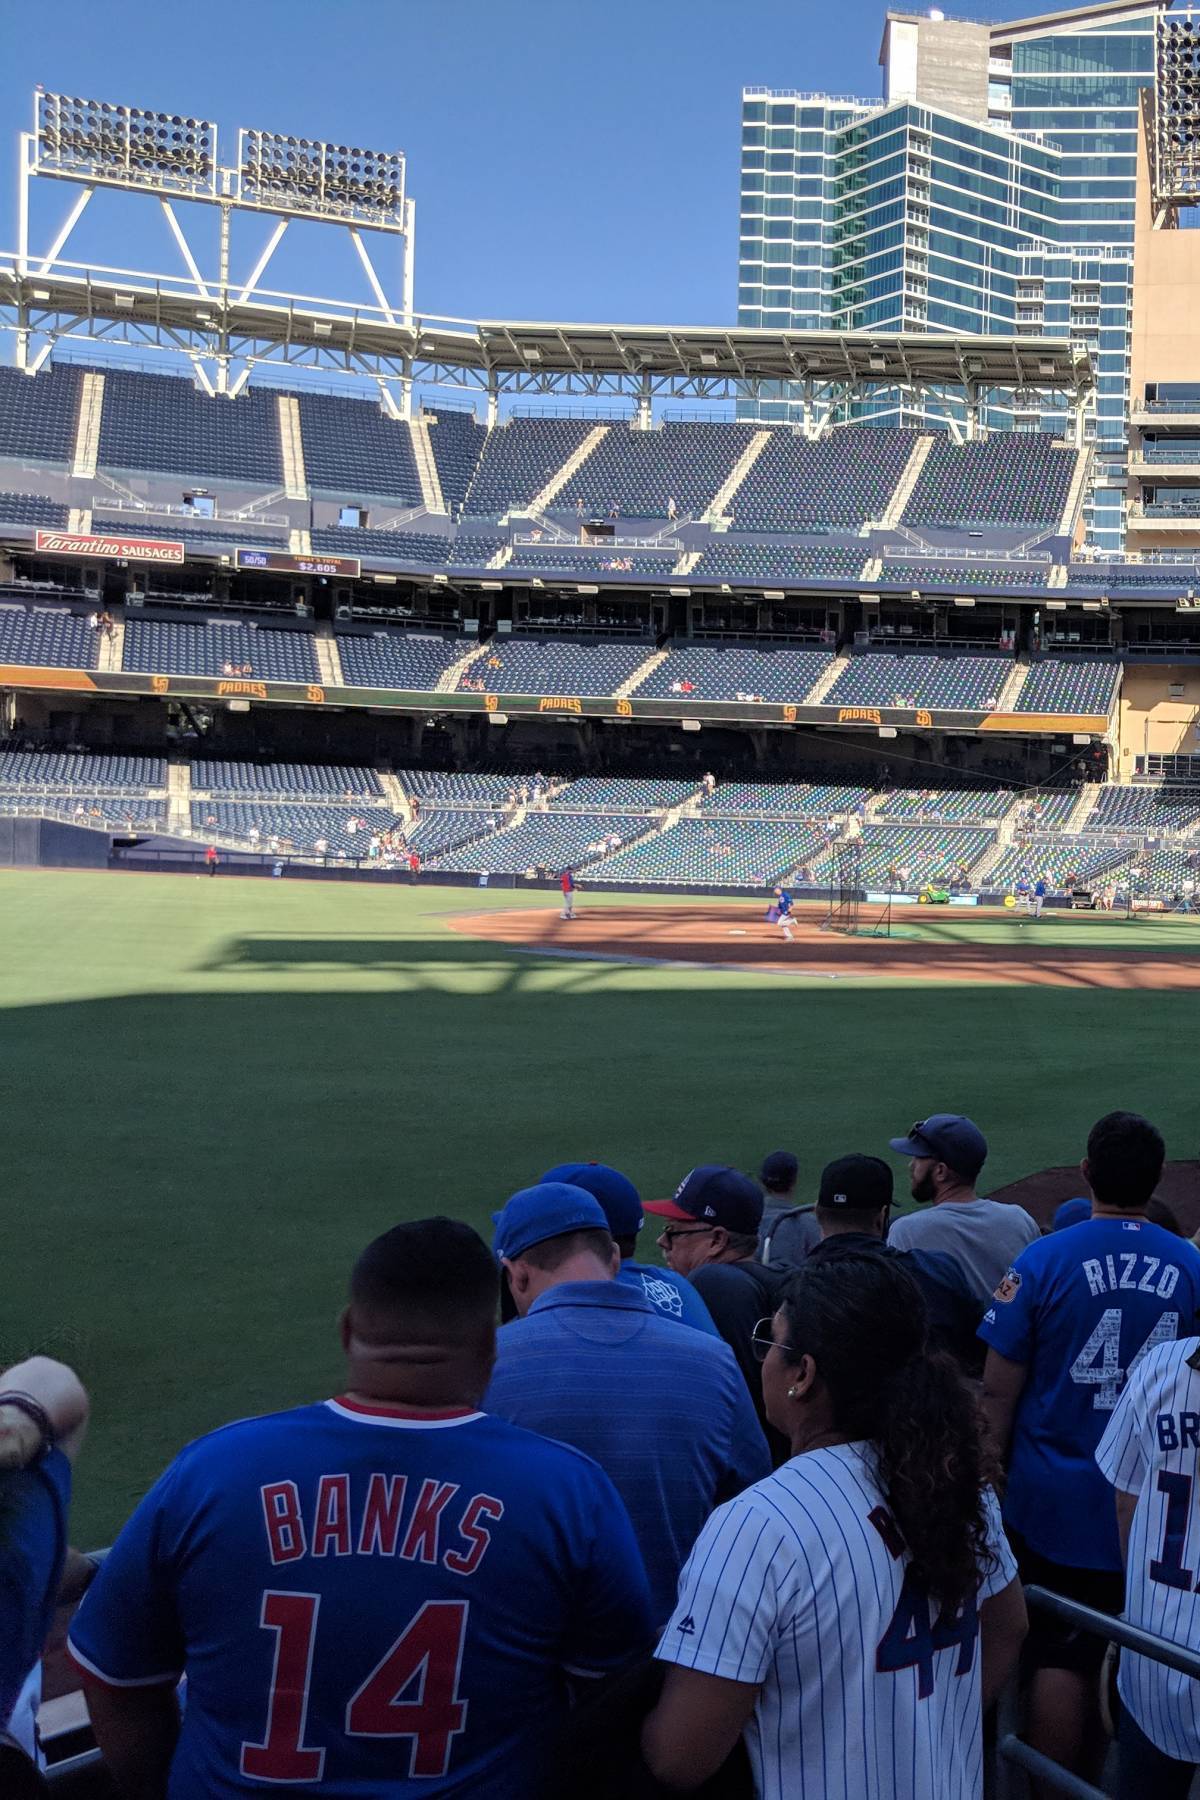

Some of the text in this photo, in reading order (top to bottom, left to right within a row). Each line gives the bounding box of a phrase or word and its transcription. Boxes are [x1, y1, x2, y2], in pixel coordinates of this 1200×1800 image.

[40, 533, 181, 560] Tarantino SAUSAGES
[217, 680, 267, 698] PADRES
[539, 697, 583, 714] PADRES
[838, 708, 882, 725] PADRES
[1082, 1252, 1180, 1300] RIZZO
[260, 1472, 504, 1576] BANKS
[240, 1589, 470, 1784] 14
